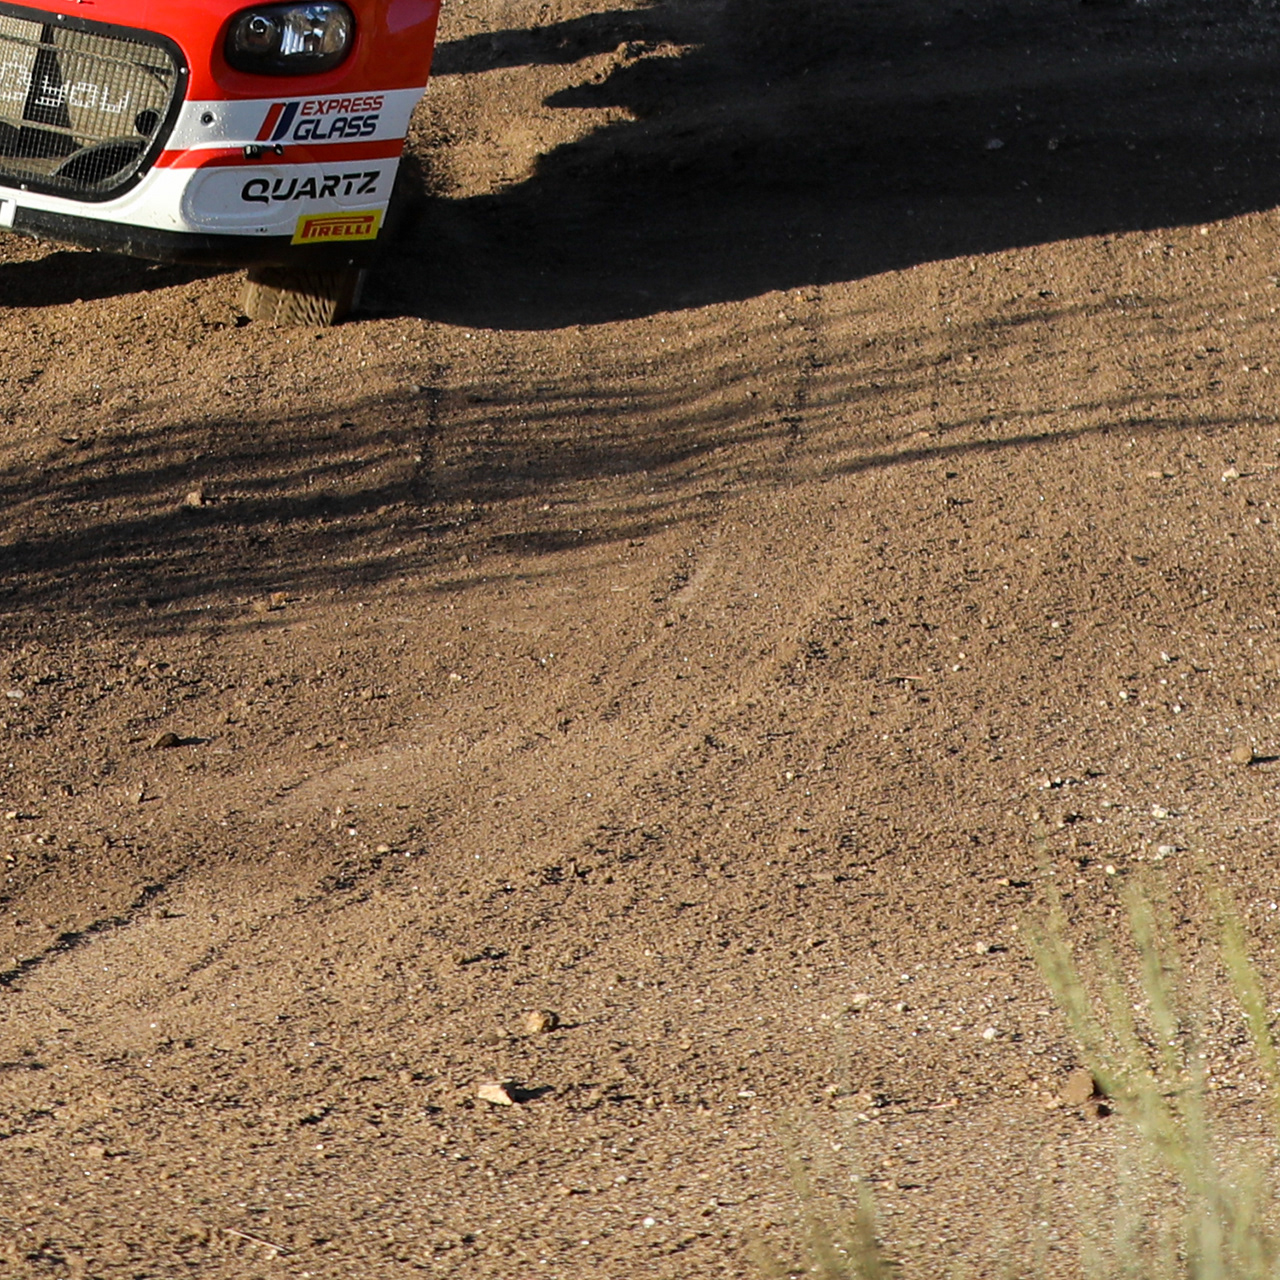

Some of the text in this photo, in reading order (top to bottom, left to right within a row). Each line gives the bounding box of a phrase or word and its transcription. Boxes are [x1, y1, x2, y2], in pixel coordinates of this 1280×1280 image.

[300, 95, 385, 116] EXPRESS
[293, 114, 380, 141] GLASS
[241, 170, 381, 205] QUARTZ
[300, 215, 376, 239] PIRELLI
